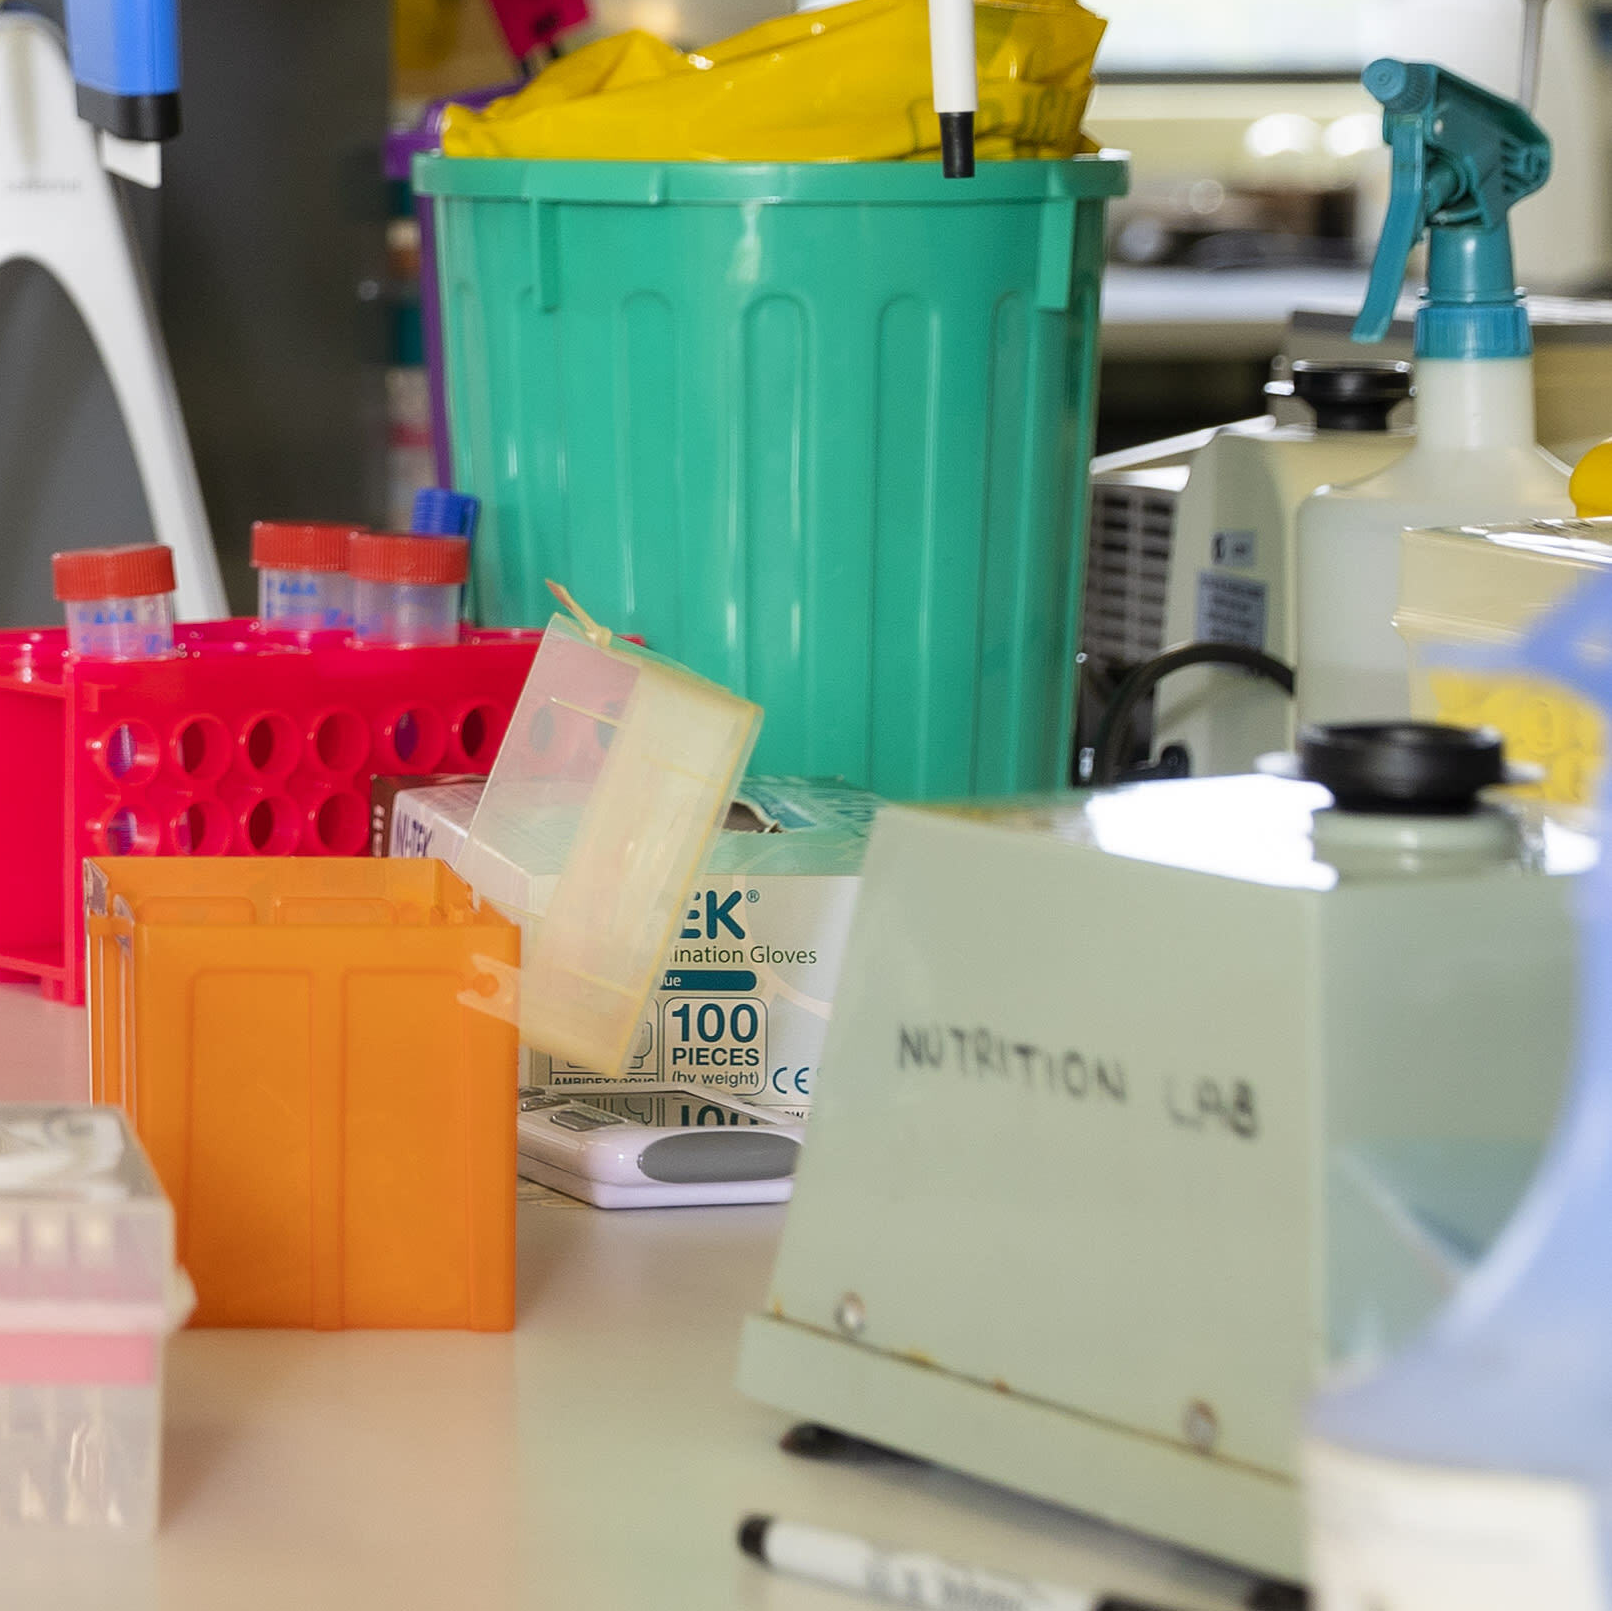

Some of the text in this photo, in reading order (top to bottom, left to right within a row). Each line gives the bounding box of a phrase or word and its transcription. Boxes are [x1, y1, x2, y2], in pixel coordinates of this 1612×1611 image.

[669, 944, 818, 965] ination Gloves
[661, 975, 682, 988] ue
[671, 1002, 759, 1043] 100
[672, 1047, 760, 1067] PIECES
[702, 1070, 760, 1089] weight)
[896, 1021, 1260, 1140] NUTRITION LAB
